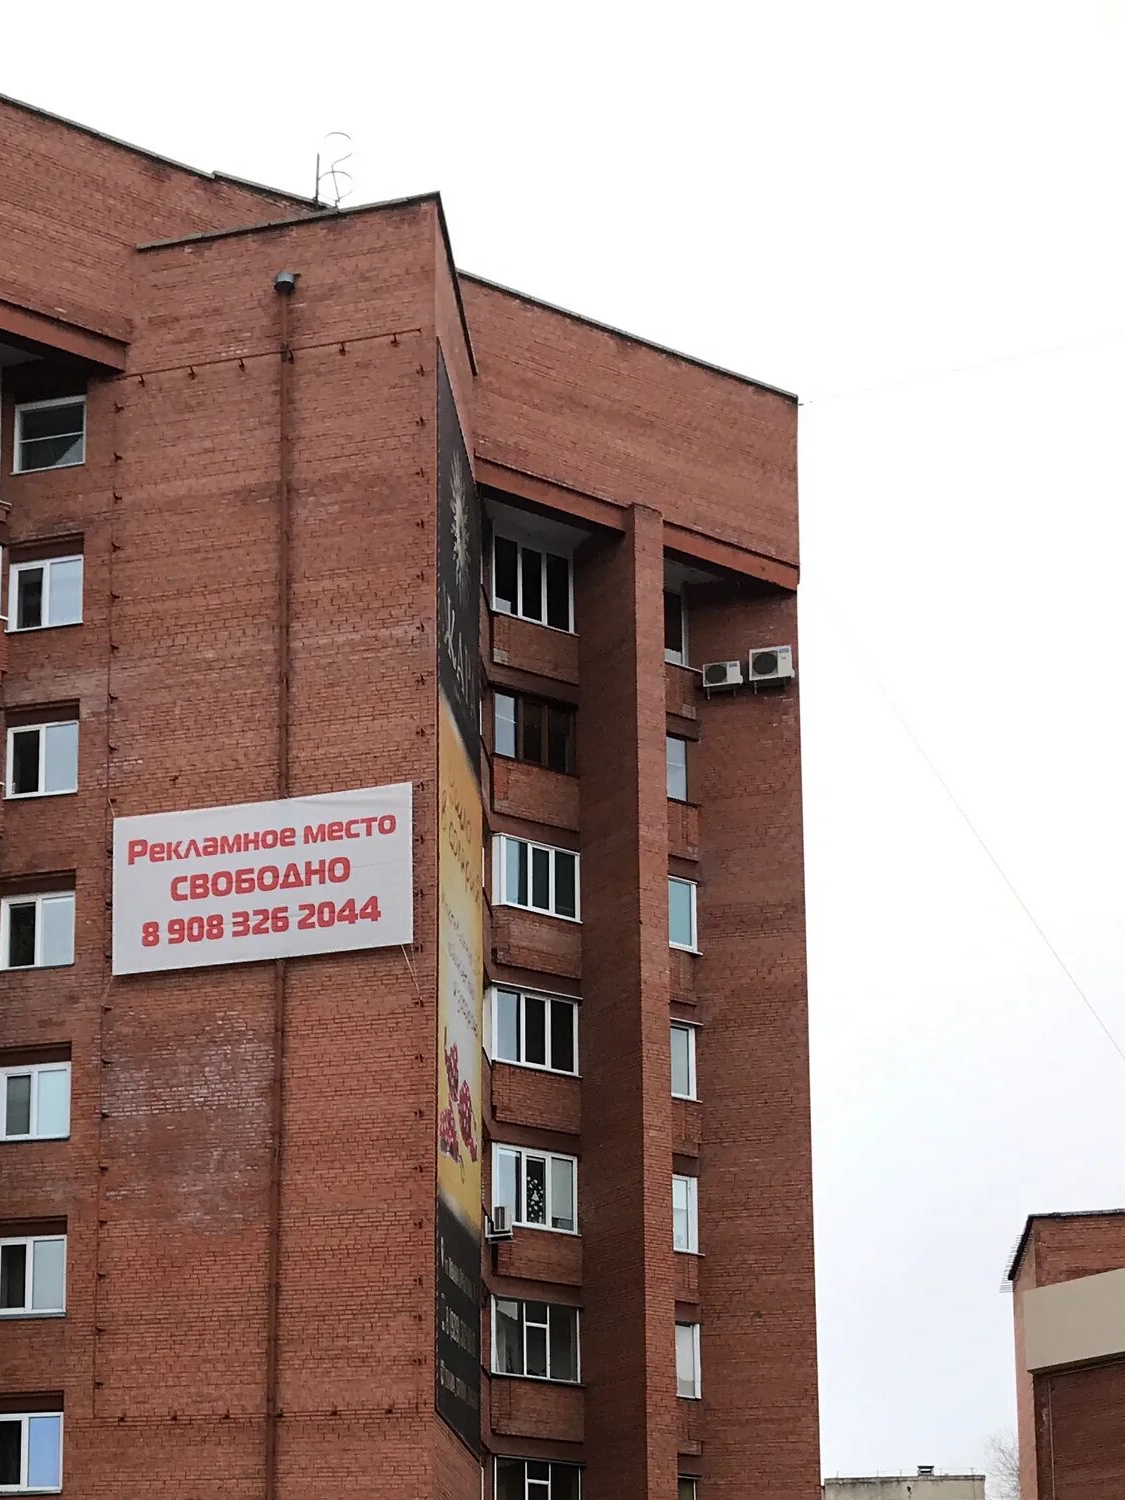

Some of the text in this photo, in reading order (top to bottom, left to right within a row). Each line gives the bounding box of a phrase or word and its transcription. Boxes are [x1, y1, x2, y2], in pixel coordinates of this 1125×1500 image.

[126, 814, 397, 865] Рекламное место
[170, 856, 351, 902] СВОБОДНО
[141, 895, 382, 947] 8 908 326 2044
